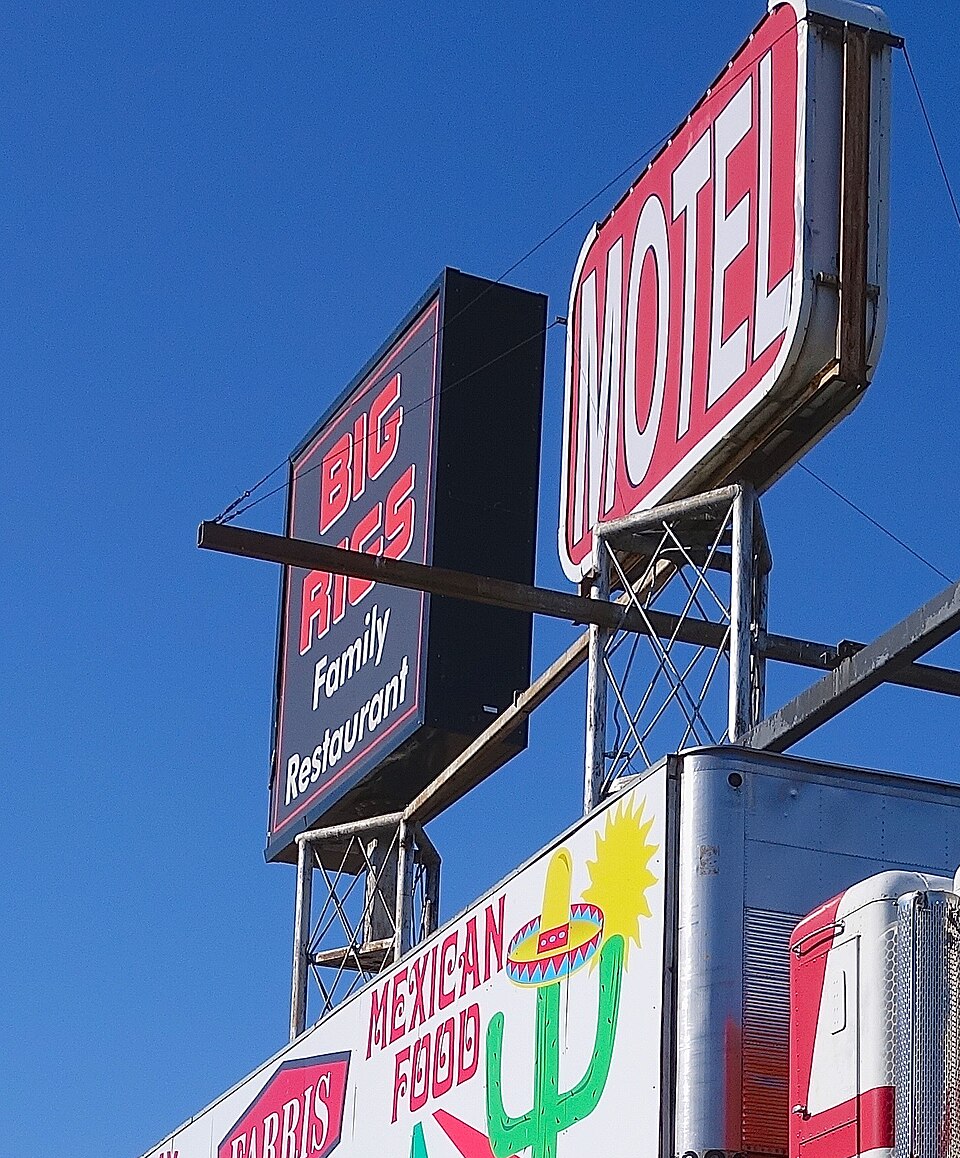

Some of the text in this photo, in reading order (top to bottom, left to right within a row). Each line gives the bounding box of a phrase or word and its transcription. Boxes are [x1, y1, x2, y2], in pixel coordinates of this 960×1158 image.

[573, 49, 793, 543] MOTEL
[319, 372, 403, 535] BIG
[299, 463, 416, 657] RIGS
[284, 656, 409, 807] Restaurant
[311, 605, 392, 711] Family
[365, 894, 506, 1060] MEXICAN
[390, 1002, 480, 1124] FOOD
